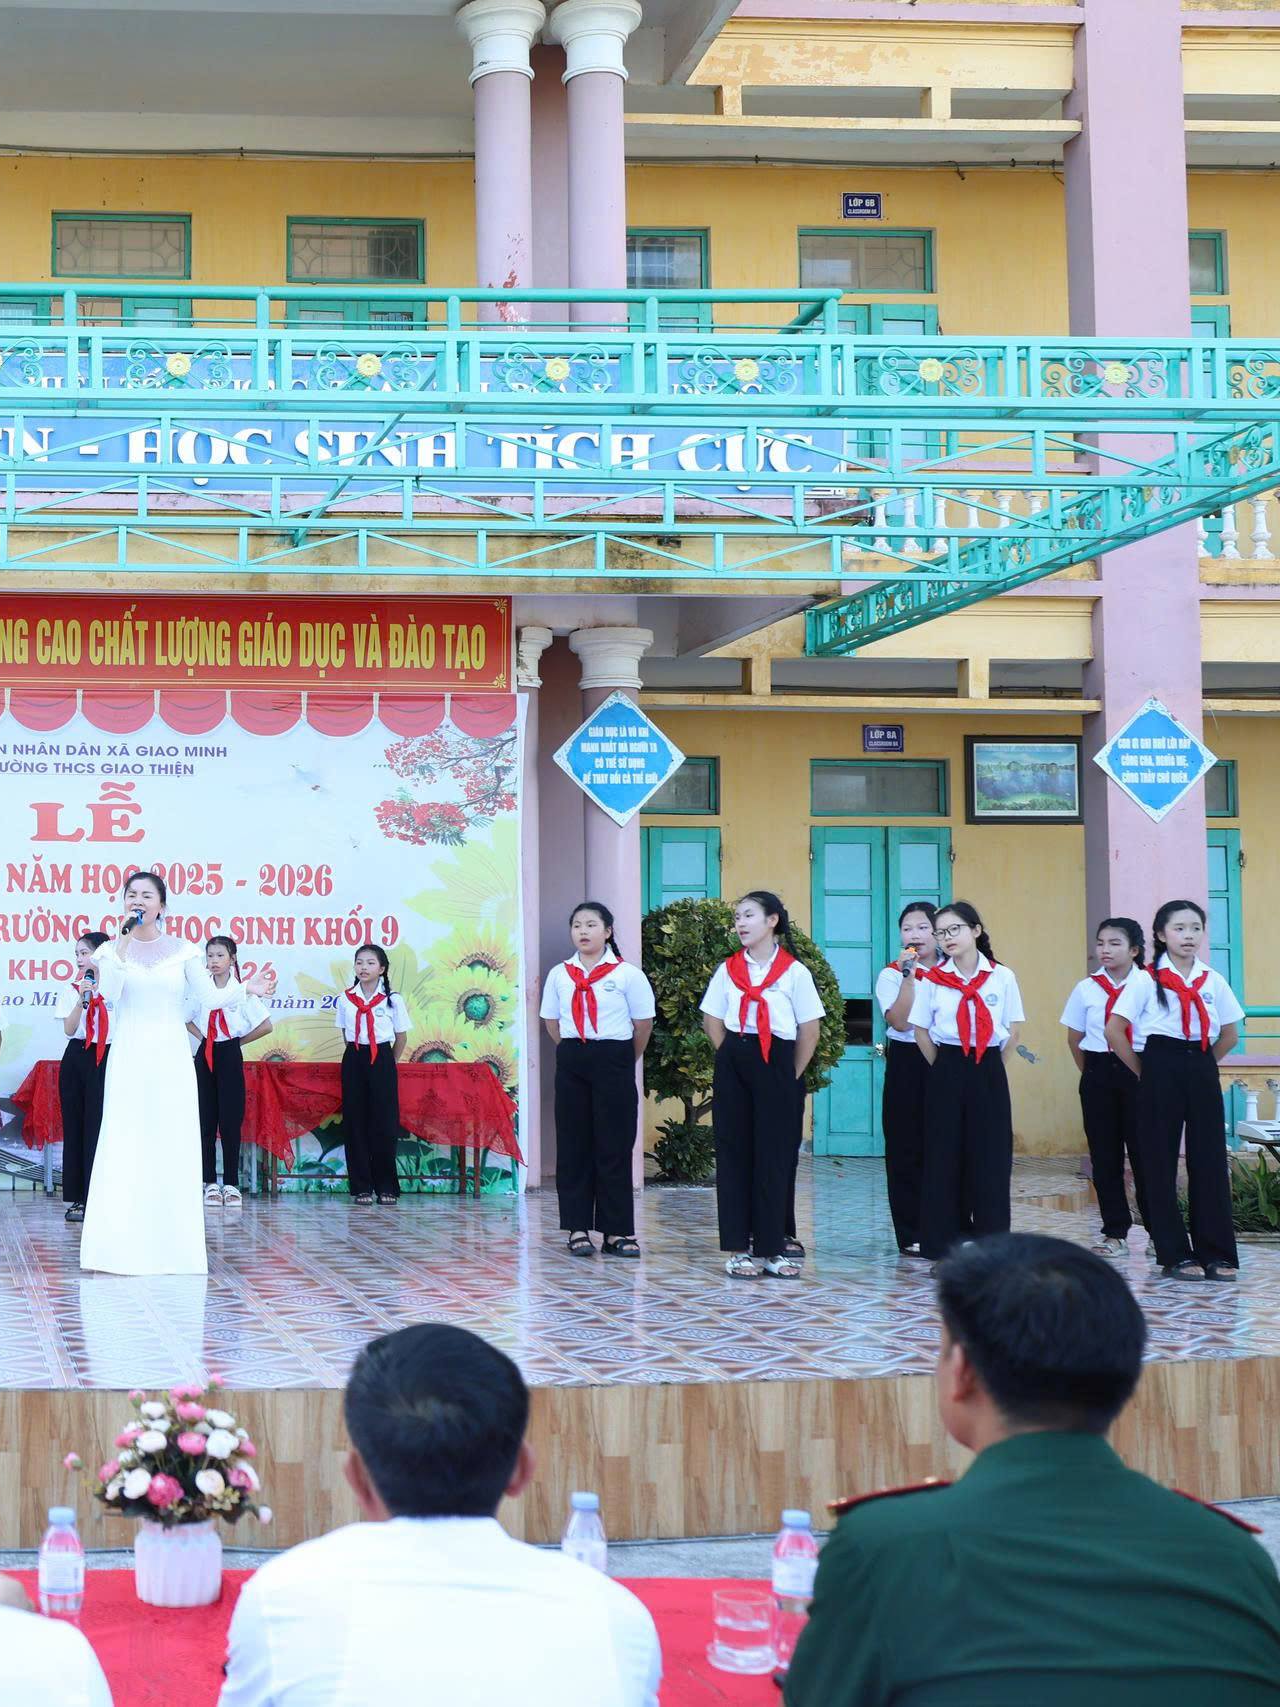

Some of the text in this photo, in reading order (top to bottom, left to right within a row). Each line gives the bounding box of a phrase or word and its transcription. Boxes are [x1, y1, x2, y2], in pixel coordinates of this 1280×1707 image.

[849, 198, 863, 206] LỚP
[78, 444, 99, 455] -
[128, 427, 275, 486] HỌC
[294, 429, 456, 468] SINH
[487, 424, 654, 470] TÍCH
[676, 428, 813, 491] CỰC
[36, 619, 81, 666] CAO
[88, 604, 148, 667] CHẤT
[155, 617, 230, 677] LƯỢNG
[238, 612, 292, 668] GIÁO
[299, 621, 346, 678] DỤC
[352, 613, 383, 669] VÀ
[388, 613, 436, 670] ĐÀO
[442, 623, 486, 680] TẠO
[870, 730, 897, 739] LỚP 8A
[13, 742, 60, 756] NHÂN
[66, 742, 100, 756] DÂN
[107, 743, 130, 756] XÃ
[136, 746, 179, 757] GIAO
[184, 746, 227, 757] MINH
[54, 762, 95, 774] THCS
[101, 763, 144, 774] GIAO
[149, 762, 194, 778] THIỆN
[29, 782, 146, 844] LỄ
[6, 853, 72, 893] NĂM
[259, 863, 333, 896] 2026
[229, 916, 295, 945] SINH
[303, 904, 373, 946] KHỐI
[381, 915, 399, 946] 9
[8, 959, 85, 981] KHO
[270, 995, 314, 1009] năm
